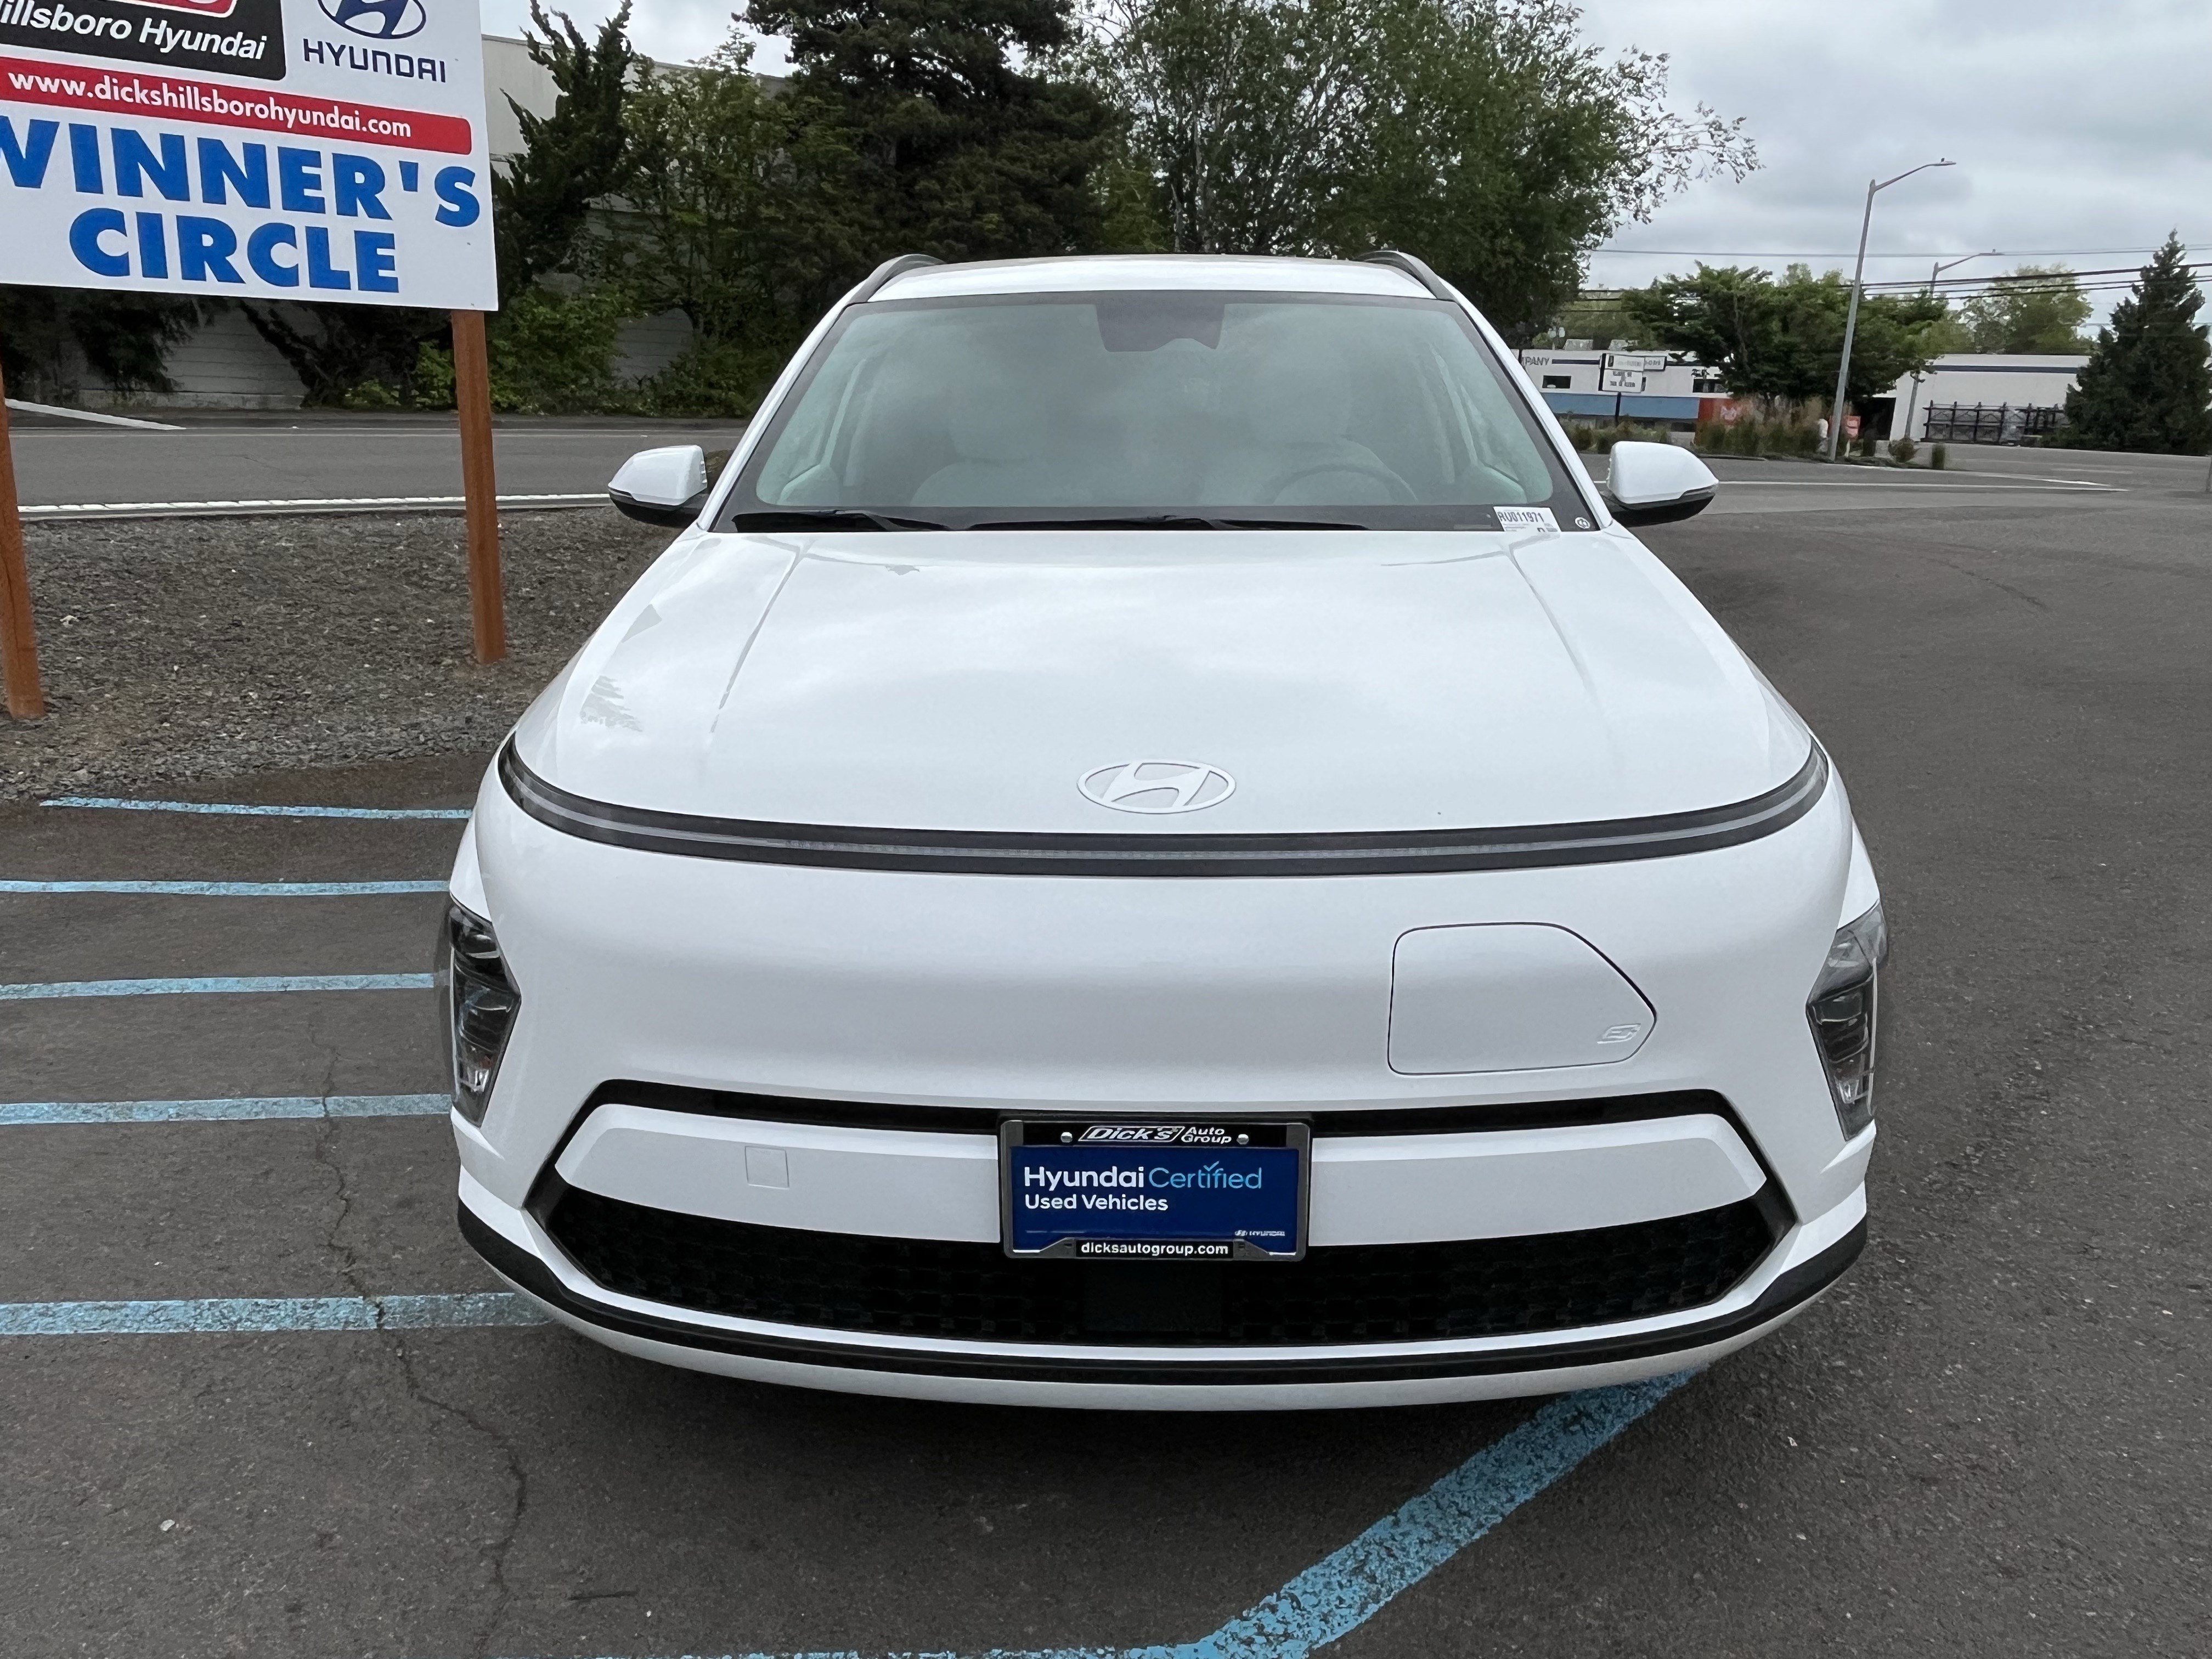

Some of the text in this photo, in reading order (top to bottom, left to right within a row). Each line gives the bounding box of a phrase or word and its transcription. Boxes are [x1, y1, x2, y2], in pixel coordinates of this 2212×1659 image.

[0, 0, 268, 60] illsboro Hyundai
[303, 38, 447, 83] HYUNDAI
[7, 69, 412, 139] www.dickshillsborohyundai.com
[69, 207, 399, 294] CIRCLE
[1087, 1127, 1178, 1140] Dick's
[1181, 1135, 1232, 1144] Group
[1188, 1126, 1225, 1136] Auto
[1024, 1161, 1262, 1192] Hyundai Certified
[1025, 1194, 1169, 1211] Used Vehicles
[1081, 1242, 1228, 1256] dicksautogroup.com
